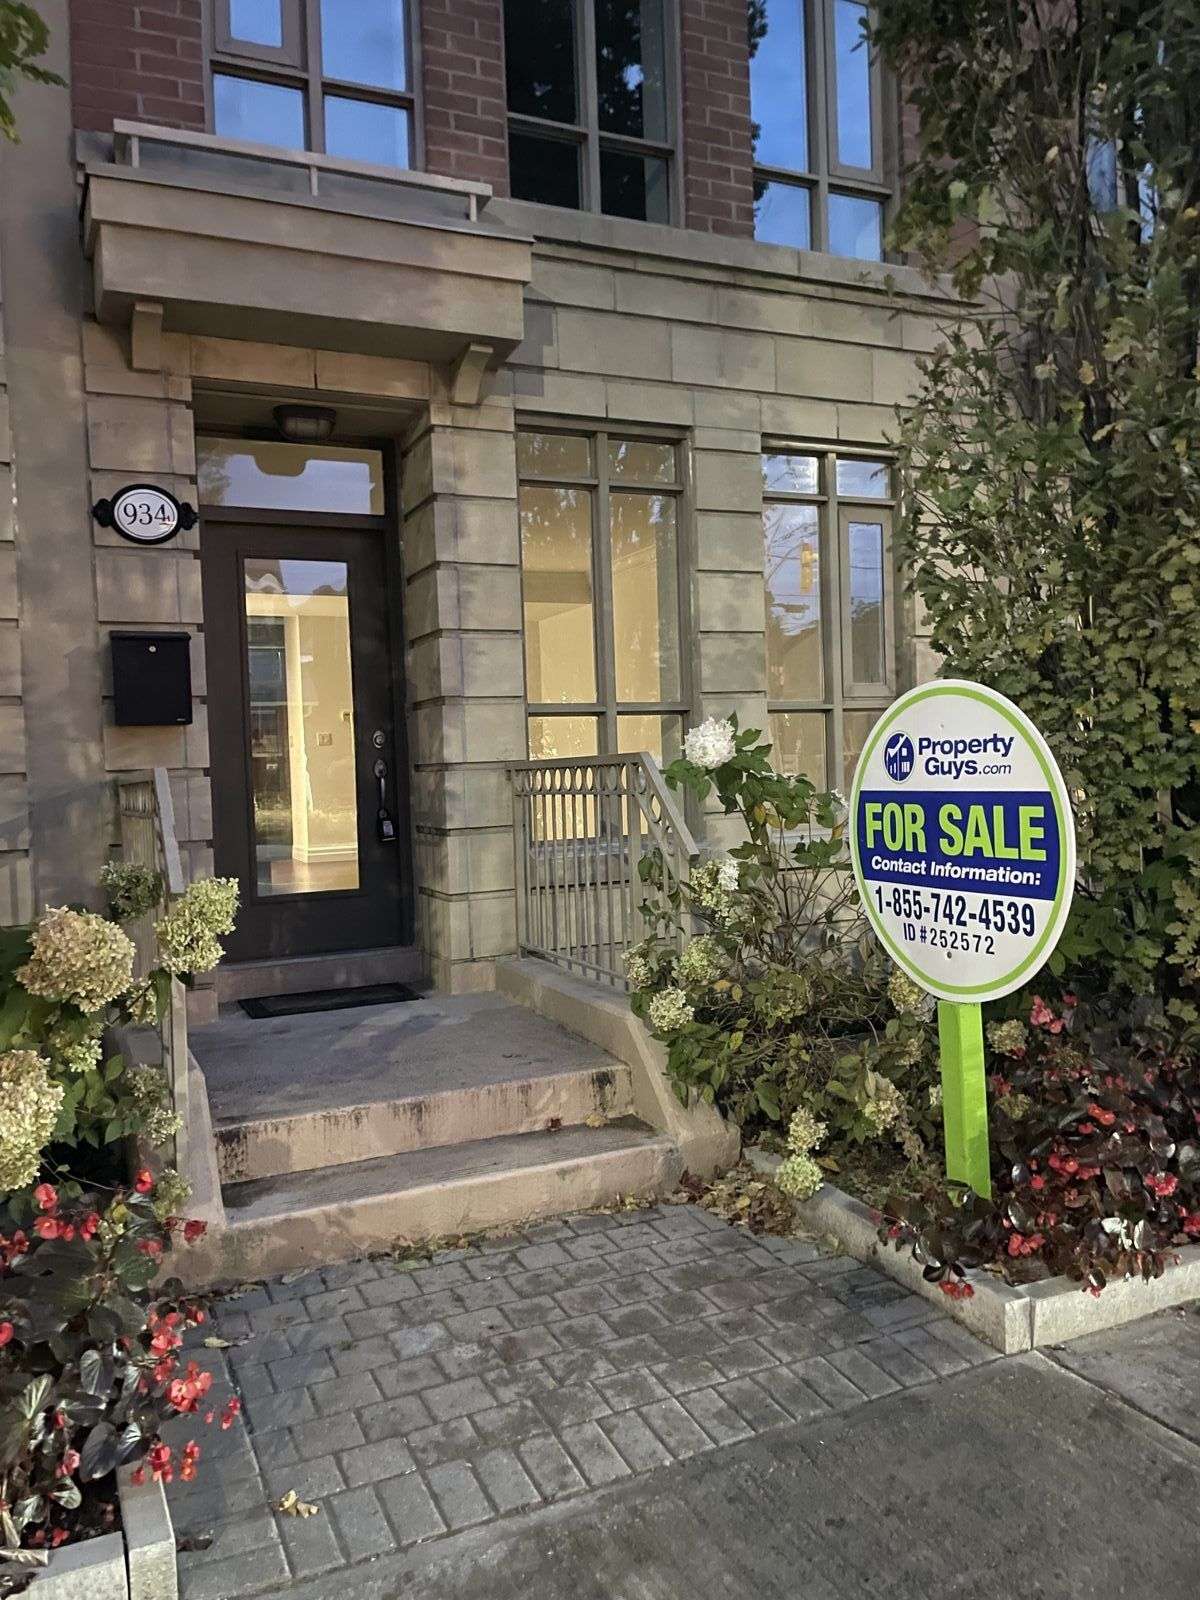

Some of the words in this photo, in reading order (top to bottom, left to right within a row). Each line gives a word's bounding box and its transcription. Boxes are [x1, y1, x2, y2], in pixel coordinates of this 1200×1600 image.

[123, 503, 170, 525] 934
[918, 733, 1014, 758] Property
[925, 757, 1011, 779] Guys.com
[865, 802, 926, 853] FOR
[939, 804, 1046, 861] SALE
[871, 855, 927, 875] Contact
[930, 861, 1041, 885] Information:
[875, 885, 1035, 937] 1-855-742-4539
